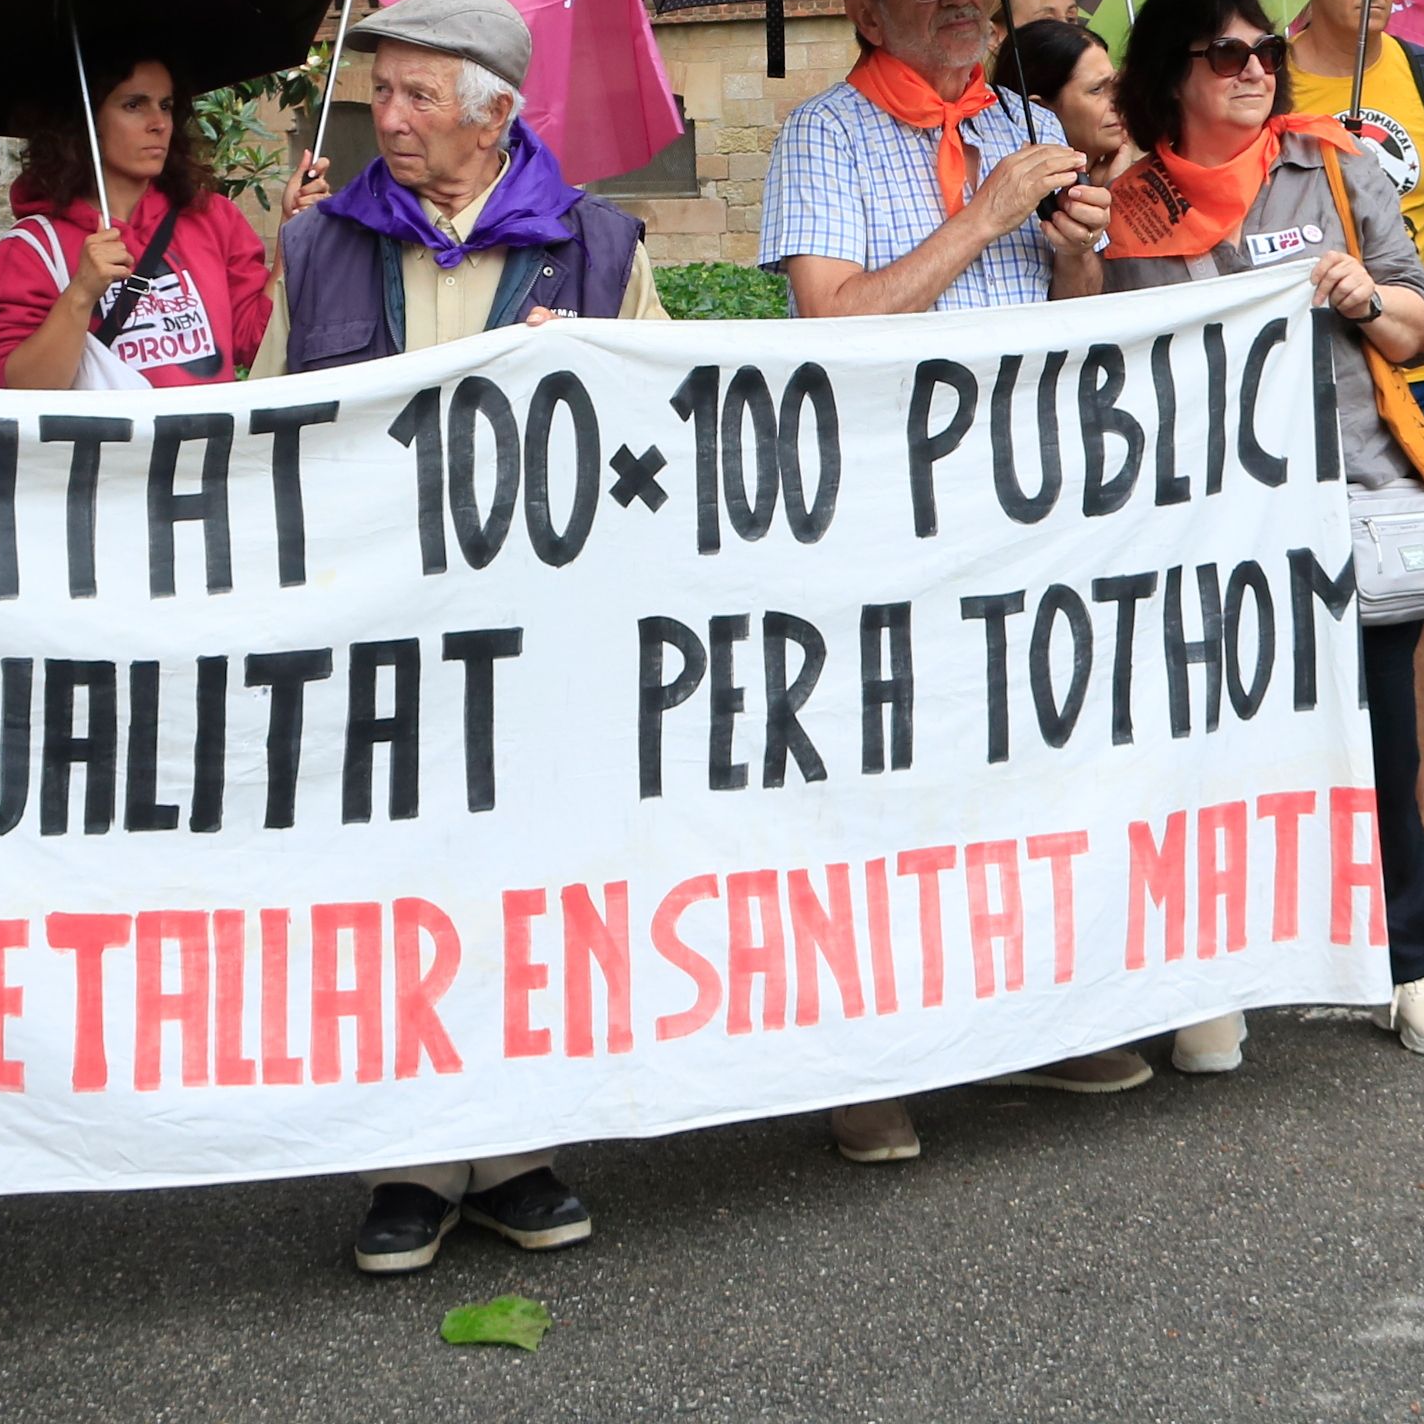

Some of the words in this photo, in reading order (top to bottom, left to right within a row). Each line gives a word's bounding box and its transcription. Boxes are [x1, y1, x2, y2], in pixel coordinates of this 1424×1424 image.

[118, 326, 211, 364] PROU!
[163, 307, 203, 332] DIEM
[638, 608, 826, 799] PER
[861, 600, 913, 775] A
[960, 547, 1369, 764] TOTHOM
[502, 879, 634, 1059] EN
[651, 829, 1088, 1043] SANITAT
[1125, 785, 1386, 971] MATA
